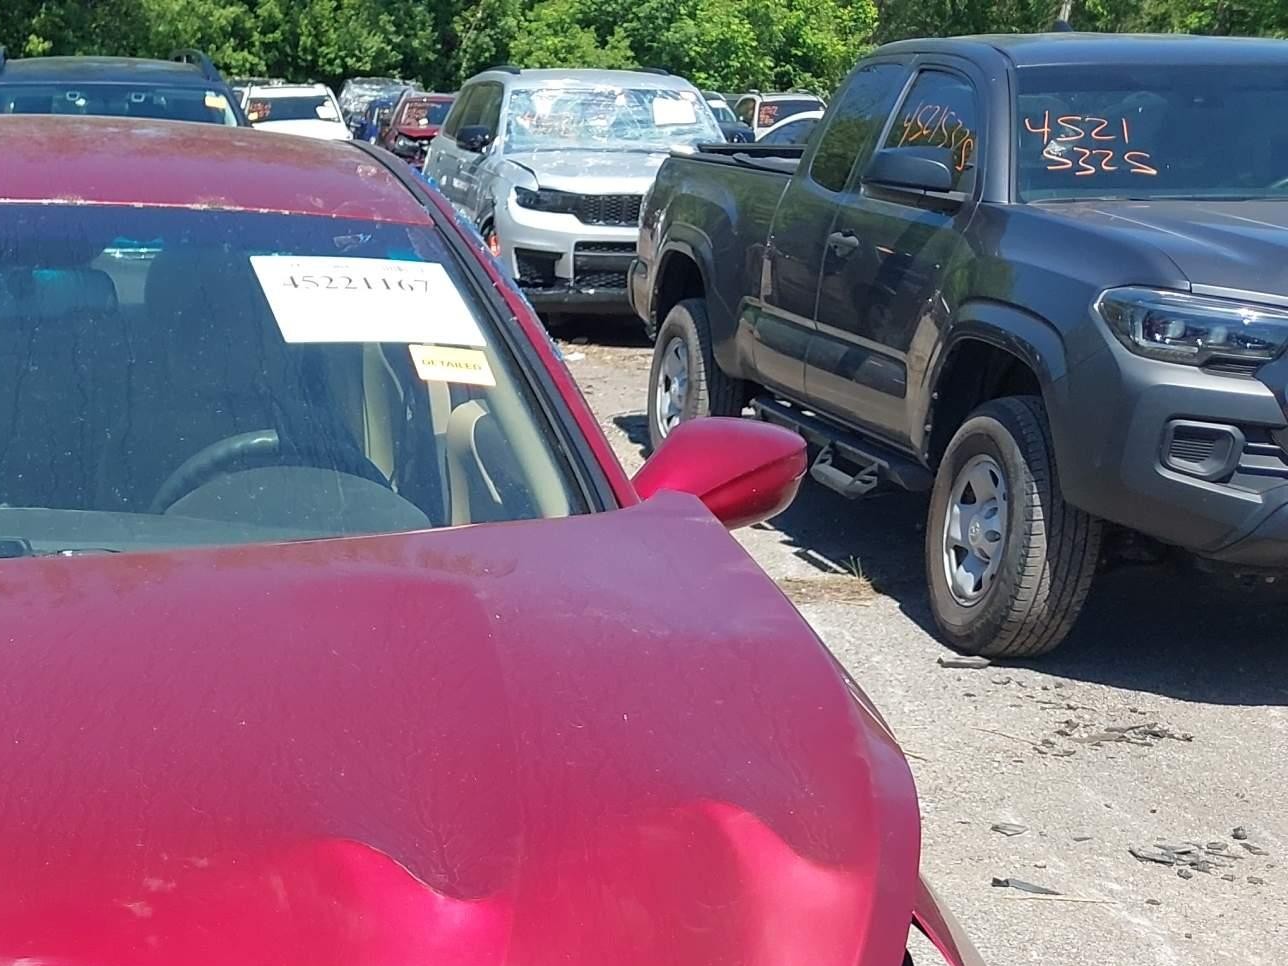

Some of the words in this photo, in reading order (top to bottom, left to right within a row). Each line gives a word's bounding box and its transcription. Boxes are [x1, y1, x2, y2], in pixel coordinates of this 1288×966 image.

[1025, 110, 1129, 144] 4521
[1043, 146, 1157, 175] 5325
[283, 275, 429, 293] 45221167
